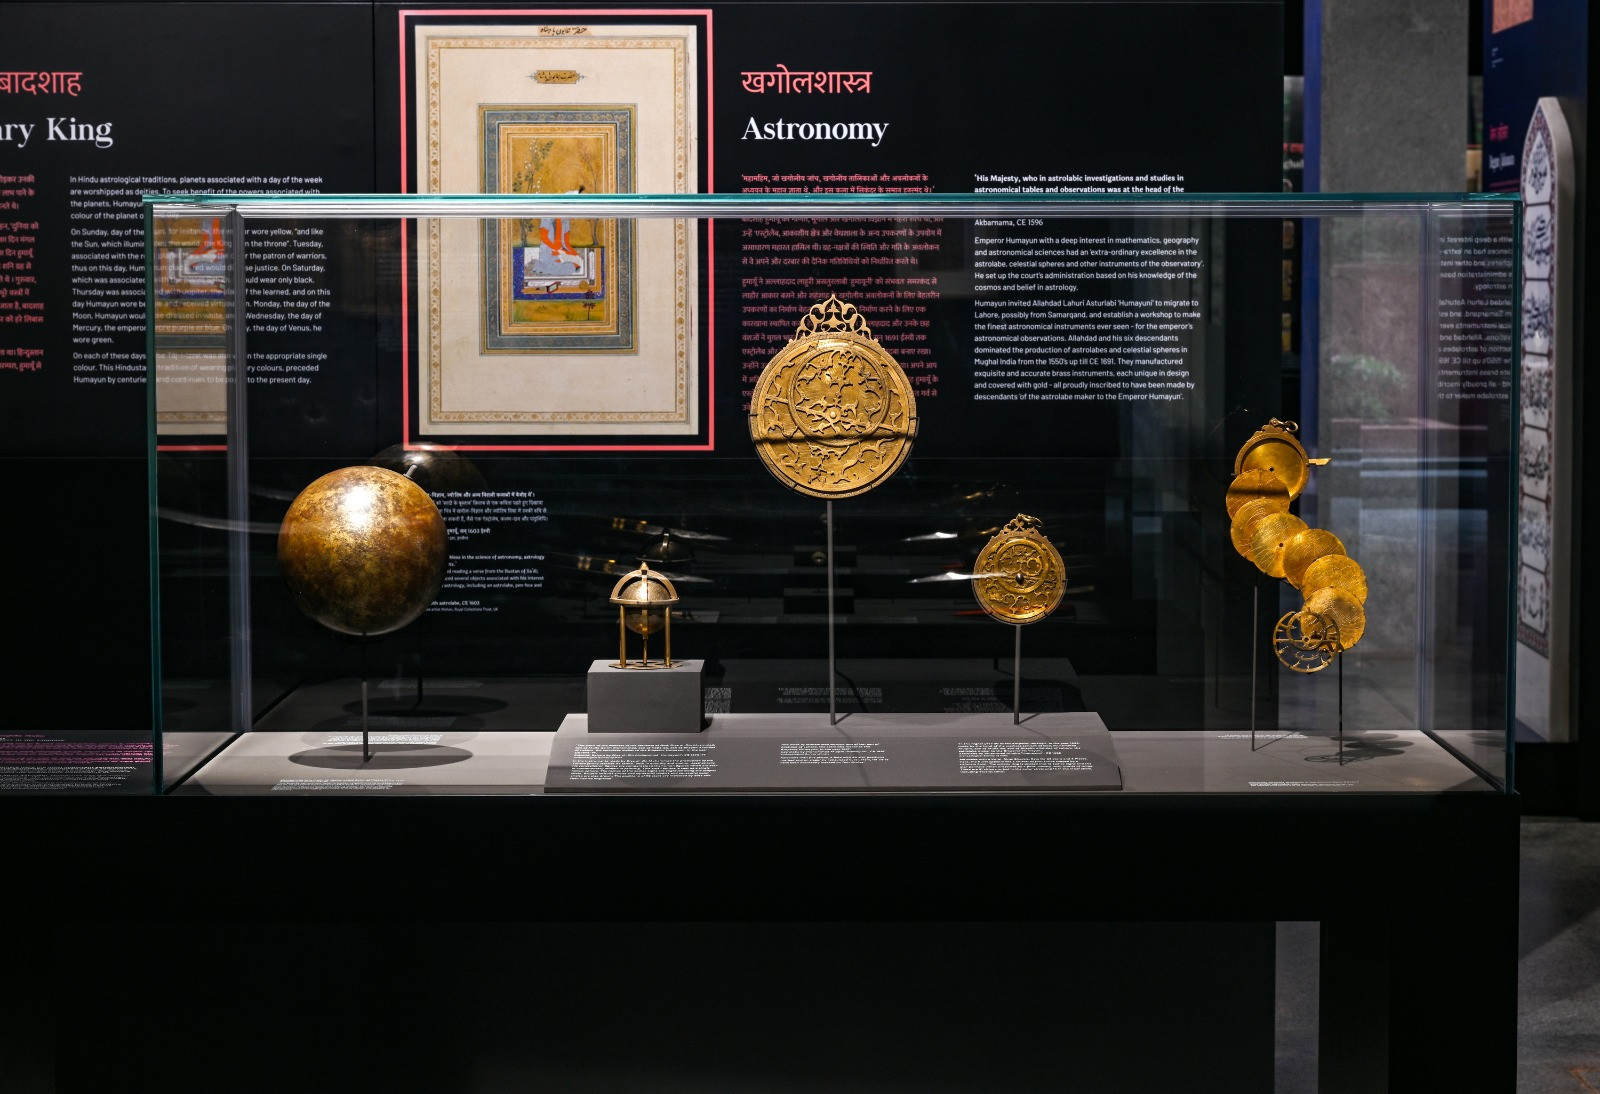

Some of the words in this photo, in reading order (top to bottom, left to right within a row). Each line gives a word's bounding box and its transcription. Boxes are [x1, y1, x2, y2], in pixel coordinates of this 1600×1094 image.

[0, 72, 82, 96] बादशाह
[741, 64, 872, 93] खगोलशास्त्र
[47, 118, 113, 148] King
[741, 117, 889, 147] Astronomy
[100, 176, 141, 184] astrological
[1085, 175, 1134, 183] investigations
[975, 237, 1004, 245] Emperor
[1163, 237, 1199, 245] geography
[1118, 358, 1134, 366] They
